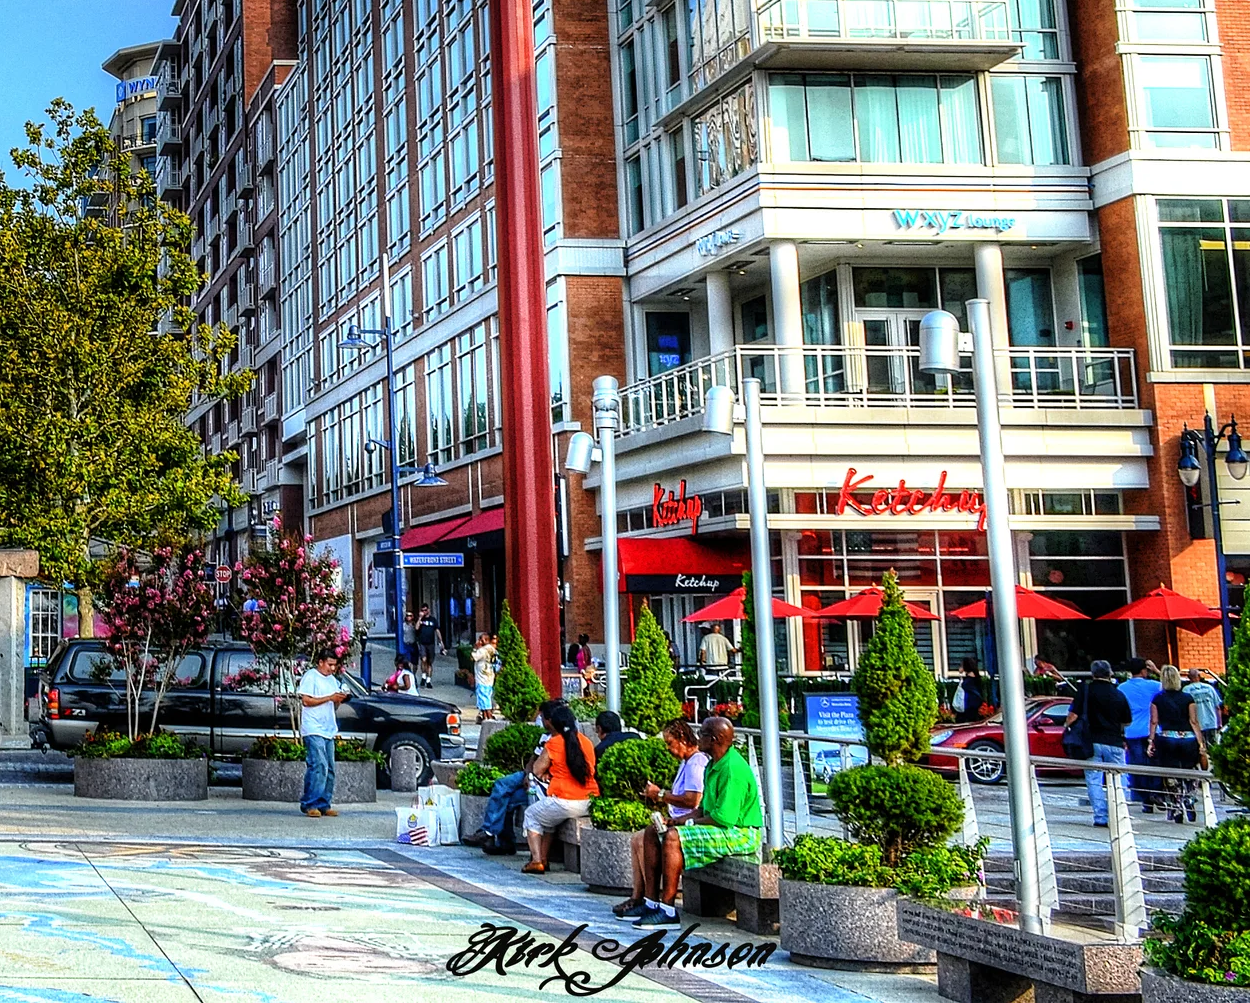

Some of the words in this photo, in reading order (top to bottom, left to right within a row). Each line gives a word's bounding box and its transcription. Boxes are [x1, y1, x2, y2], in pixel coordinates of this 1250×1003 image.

[653, 479, 702, 535] Ketchup
[216, 570, 231, 578] STOP
[675, 573, 720, 592] Ketchup
